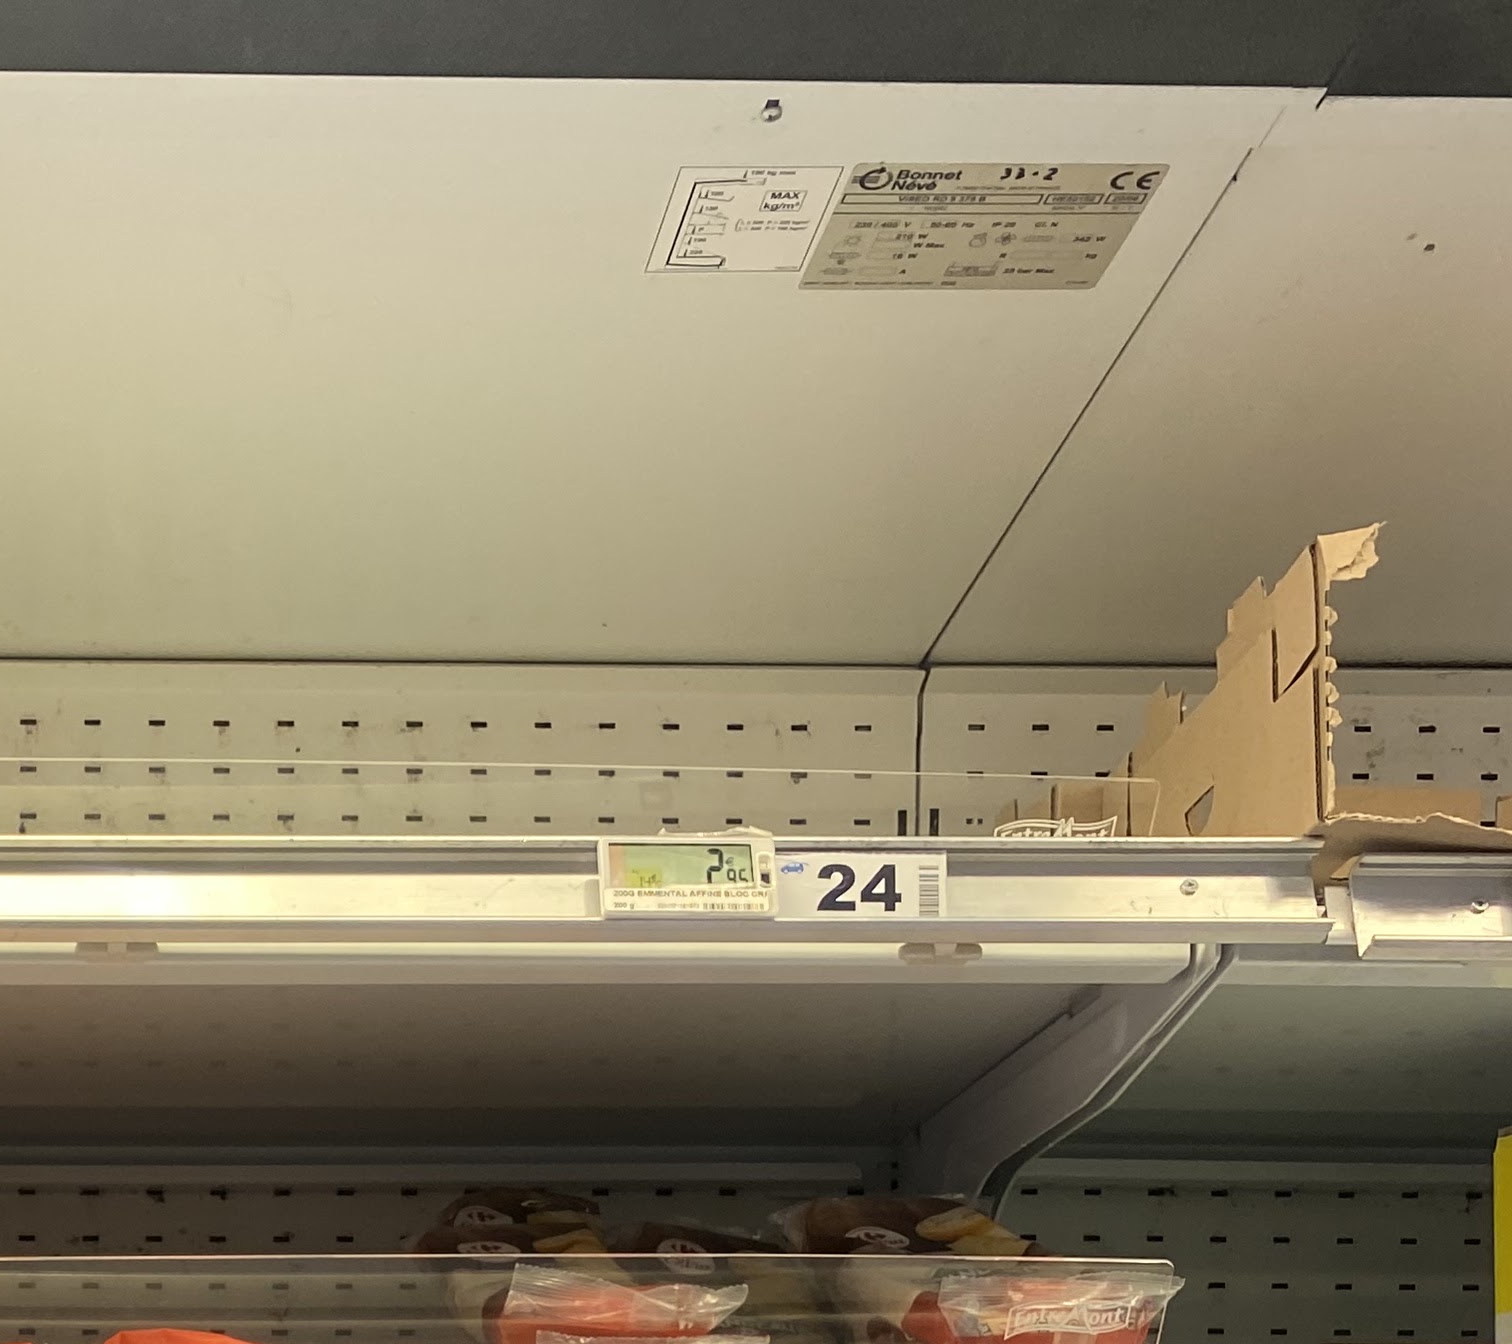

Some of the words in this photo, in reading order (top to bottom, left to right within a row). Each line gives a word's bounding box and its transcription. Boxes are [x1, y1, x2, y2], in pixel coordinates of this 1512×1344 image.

[896, 169, 962, 181] Bonnet
[1110, 171, 1160, 190] CE
[770, 192, 800, 200] MAX
[817, 864, 901, 912] 24
